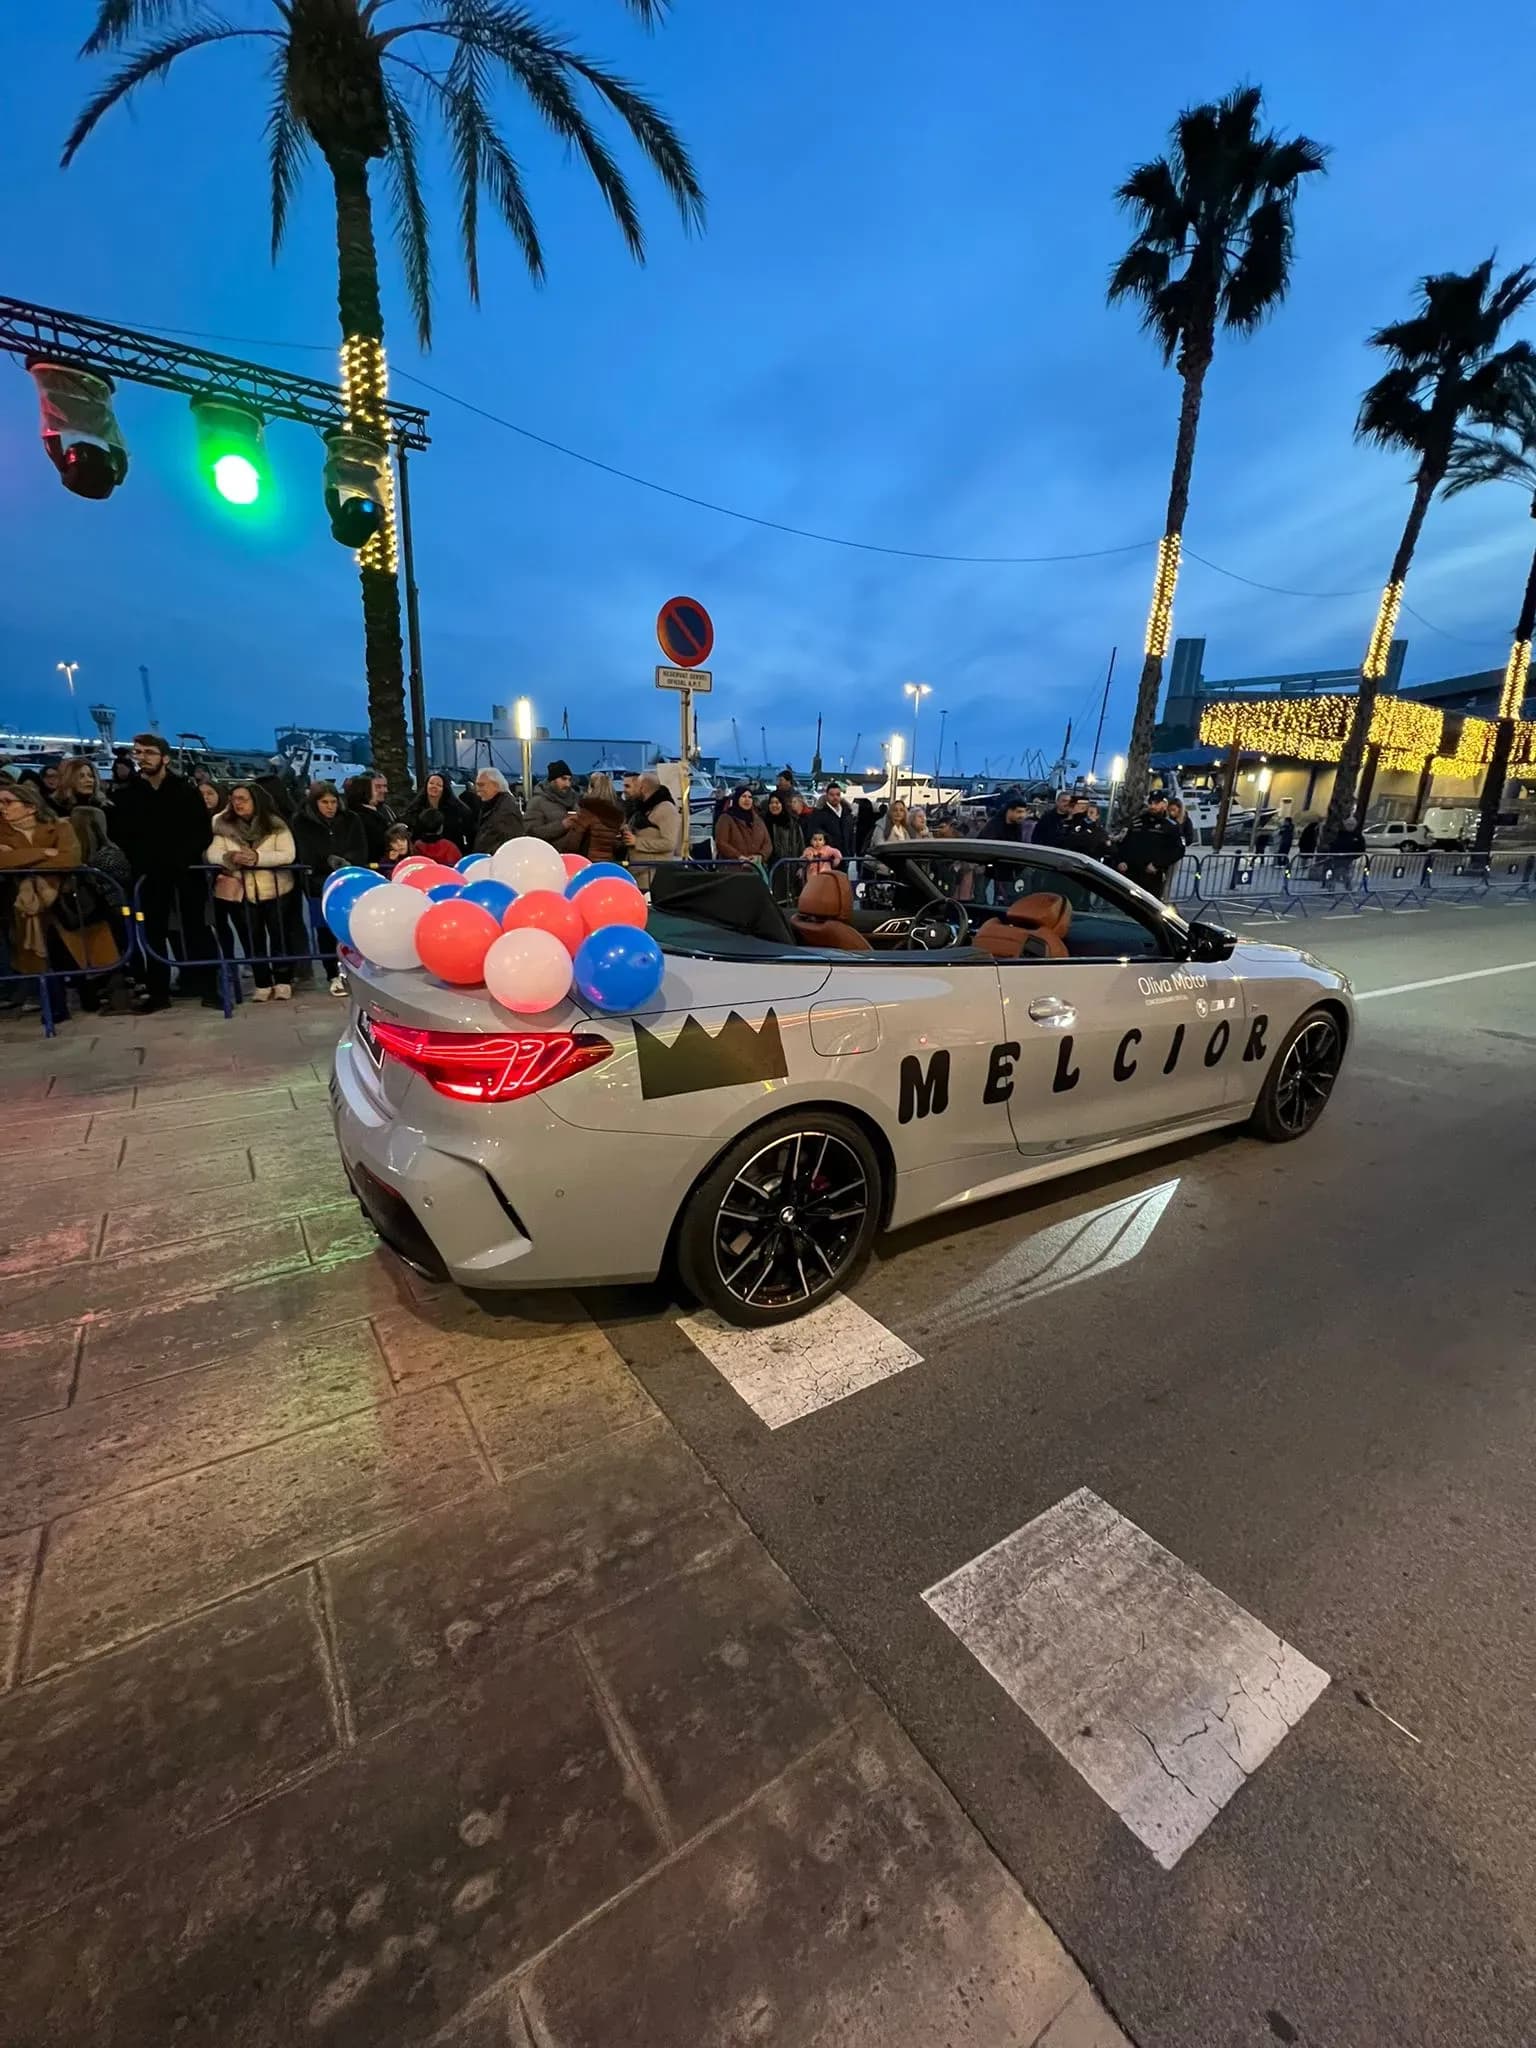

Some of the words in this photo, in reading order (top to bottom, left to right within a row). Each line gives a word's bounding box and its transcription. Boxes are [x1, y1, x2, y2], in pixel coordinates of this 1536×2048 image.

[1138, 976, 1172, 995] Oliva
[1171, 973, 1208, 990] Motor
[898, 1015, 1268, 1124] MELCIOR
